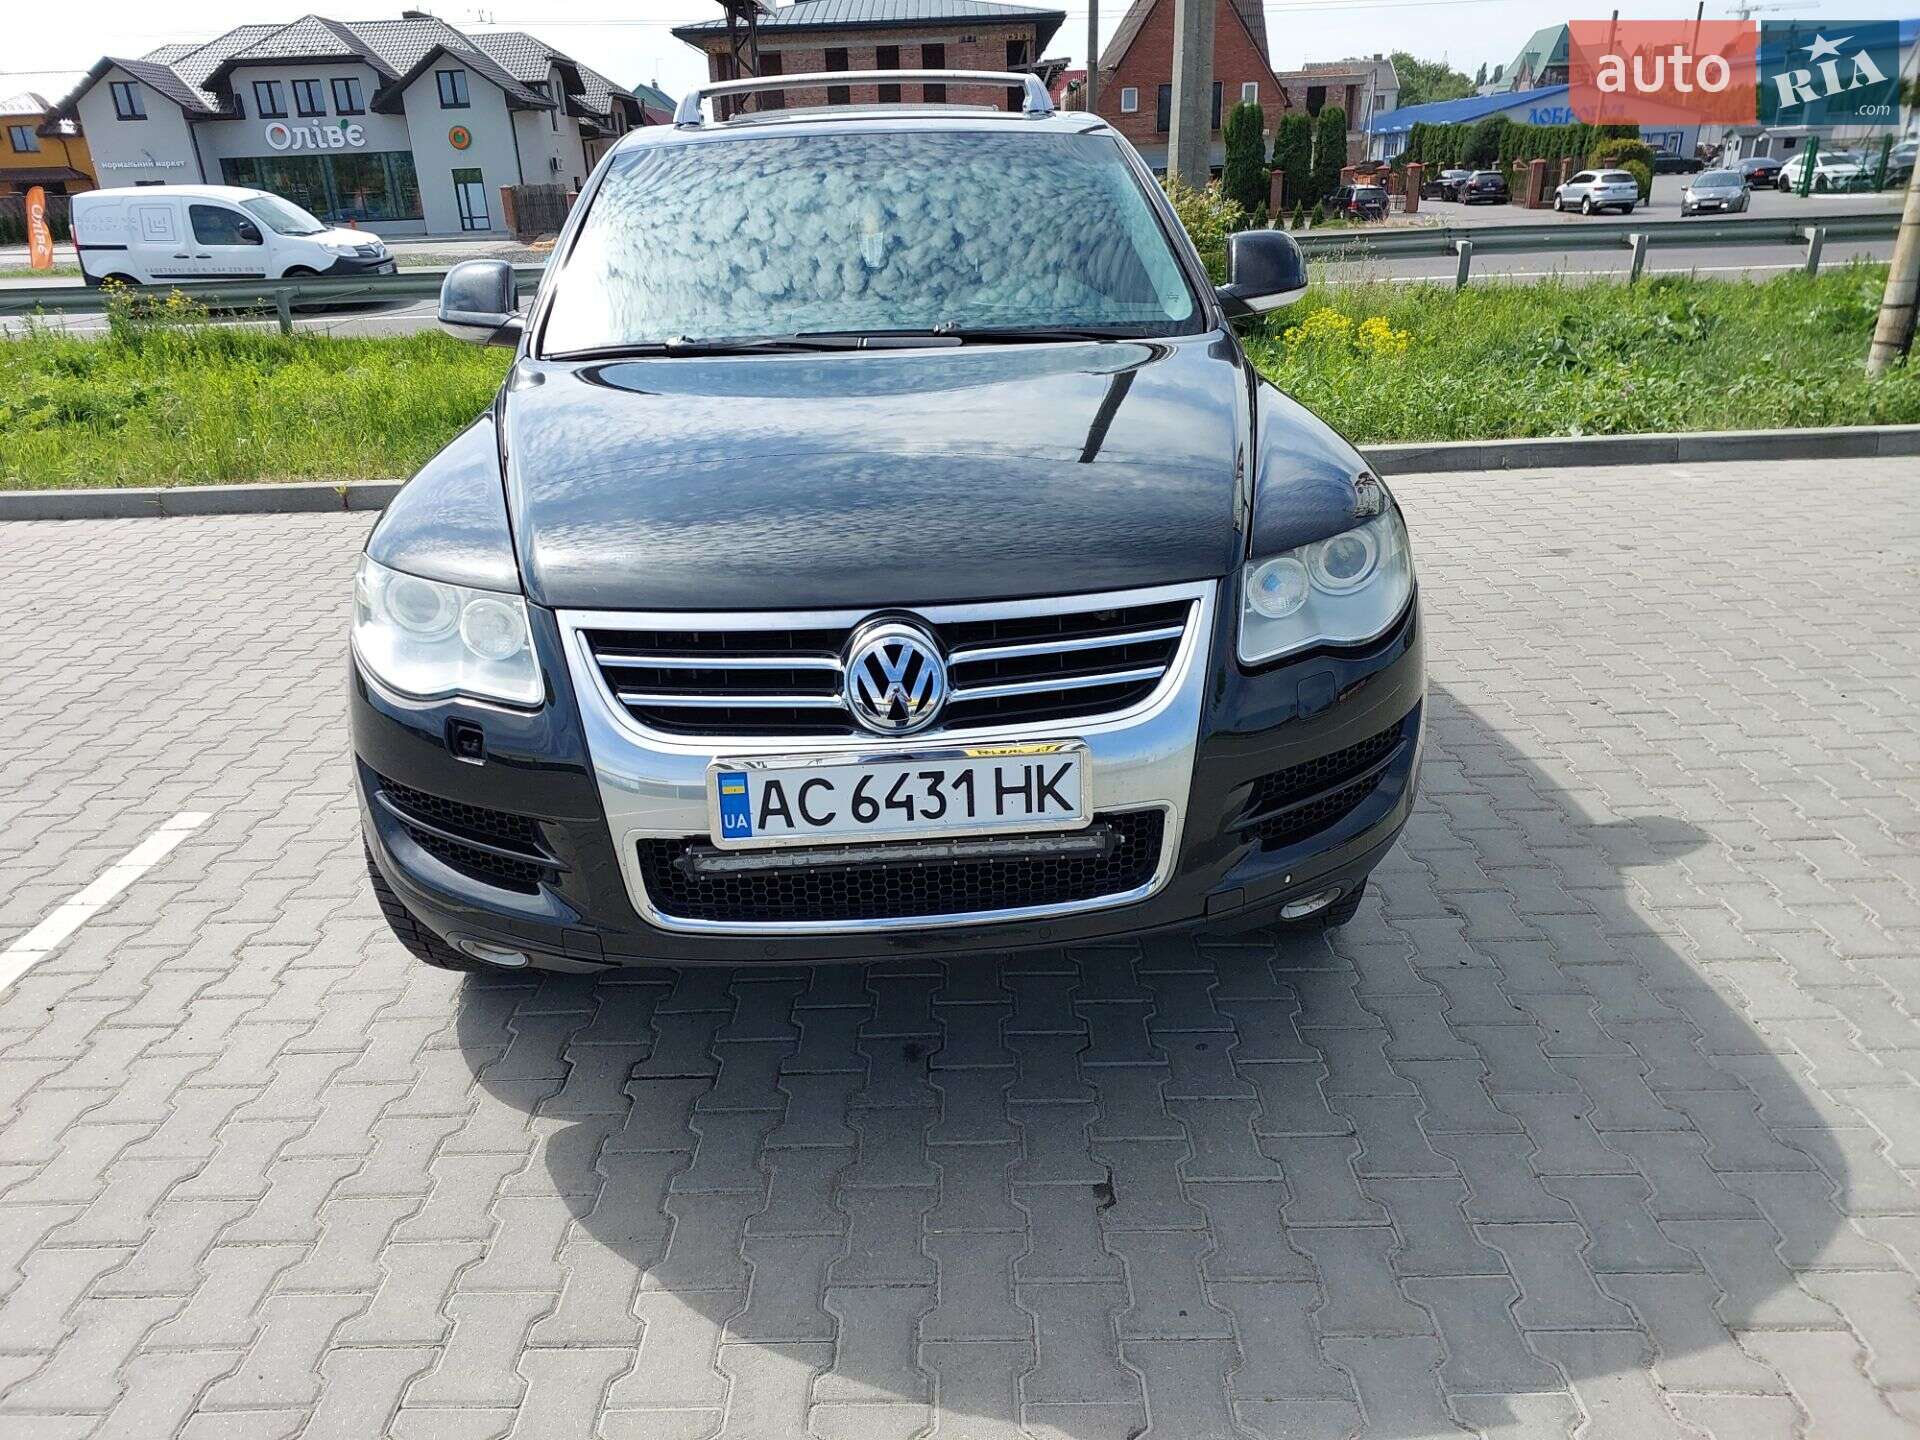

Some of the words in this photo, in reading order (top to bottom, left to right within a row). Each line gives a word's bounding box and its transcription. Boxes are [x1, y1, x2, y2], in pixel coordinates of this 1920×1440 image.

[724, 813, 749, 830] UA
[757, 778, 837, 830] AC
[851, 769, 976, 822] 6431
[994, 762, 1075, 816] HK
